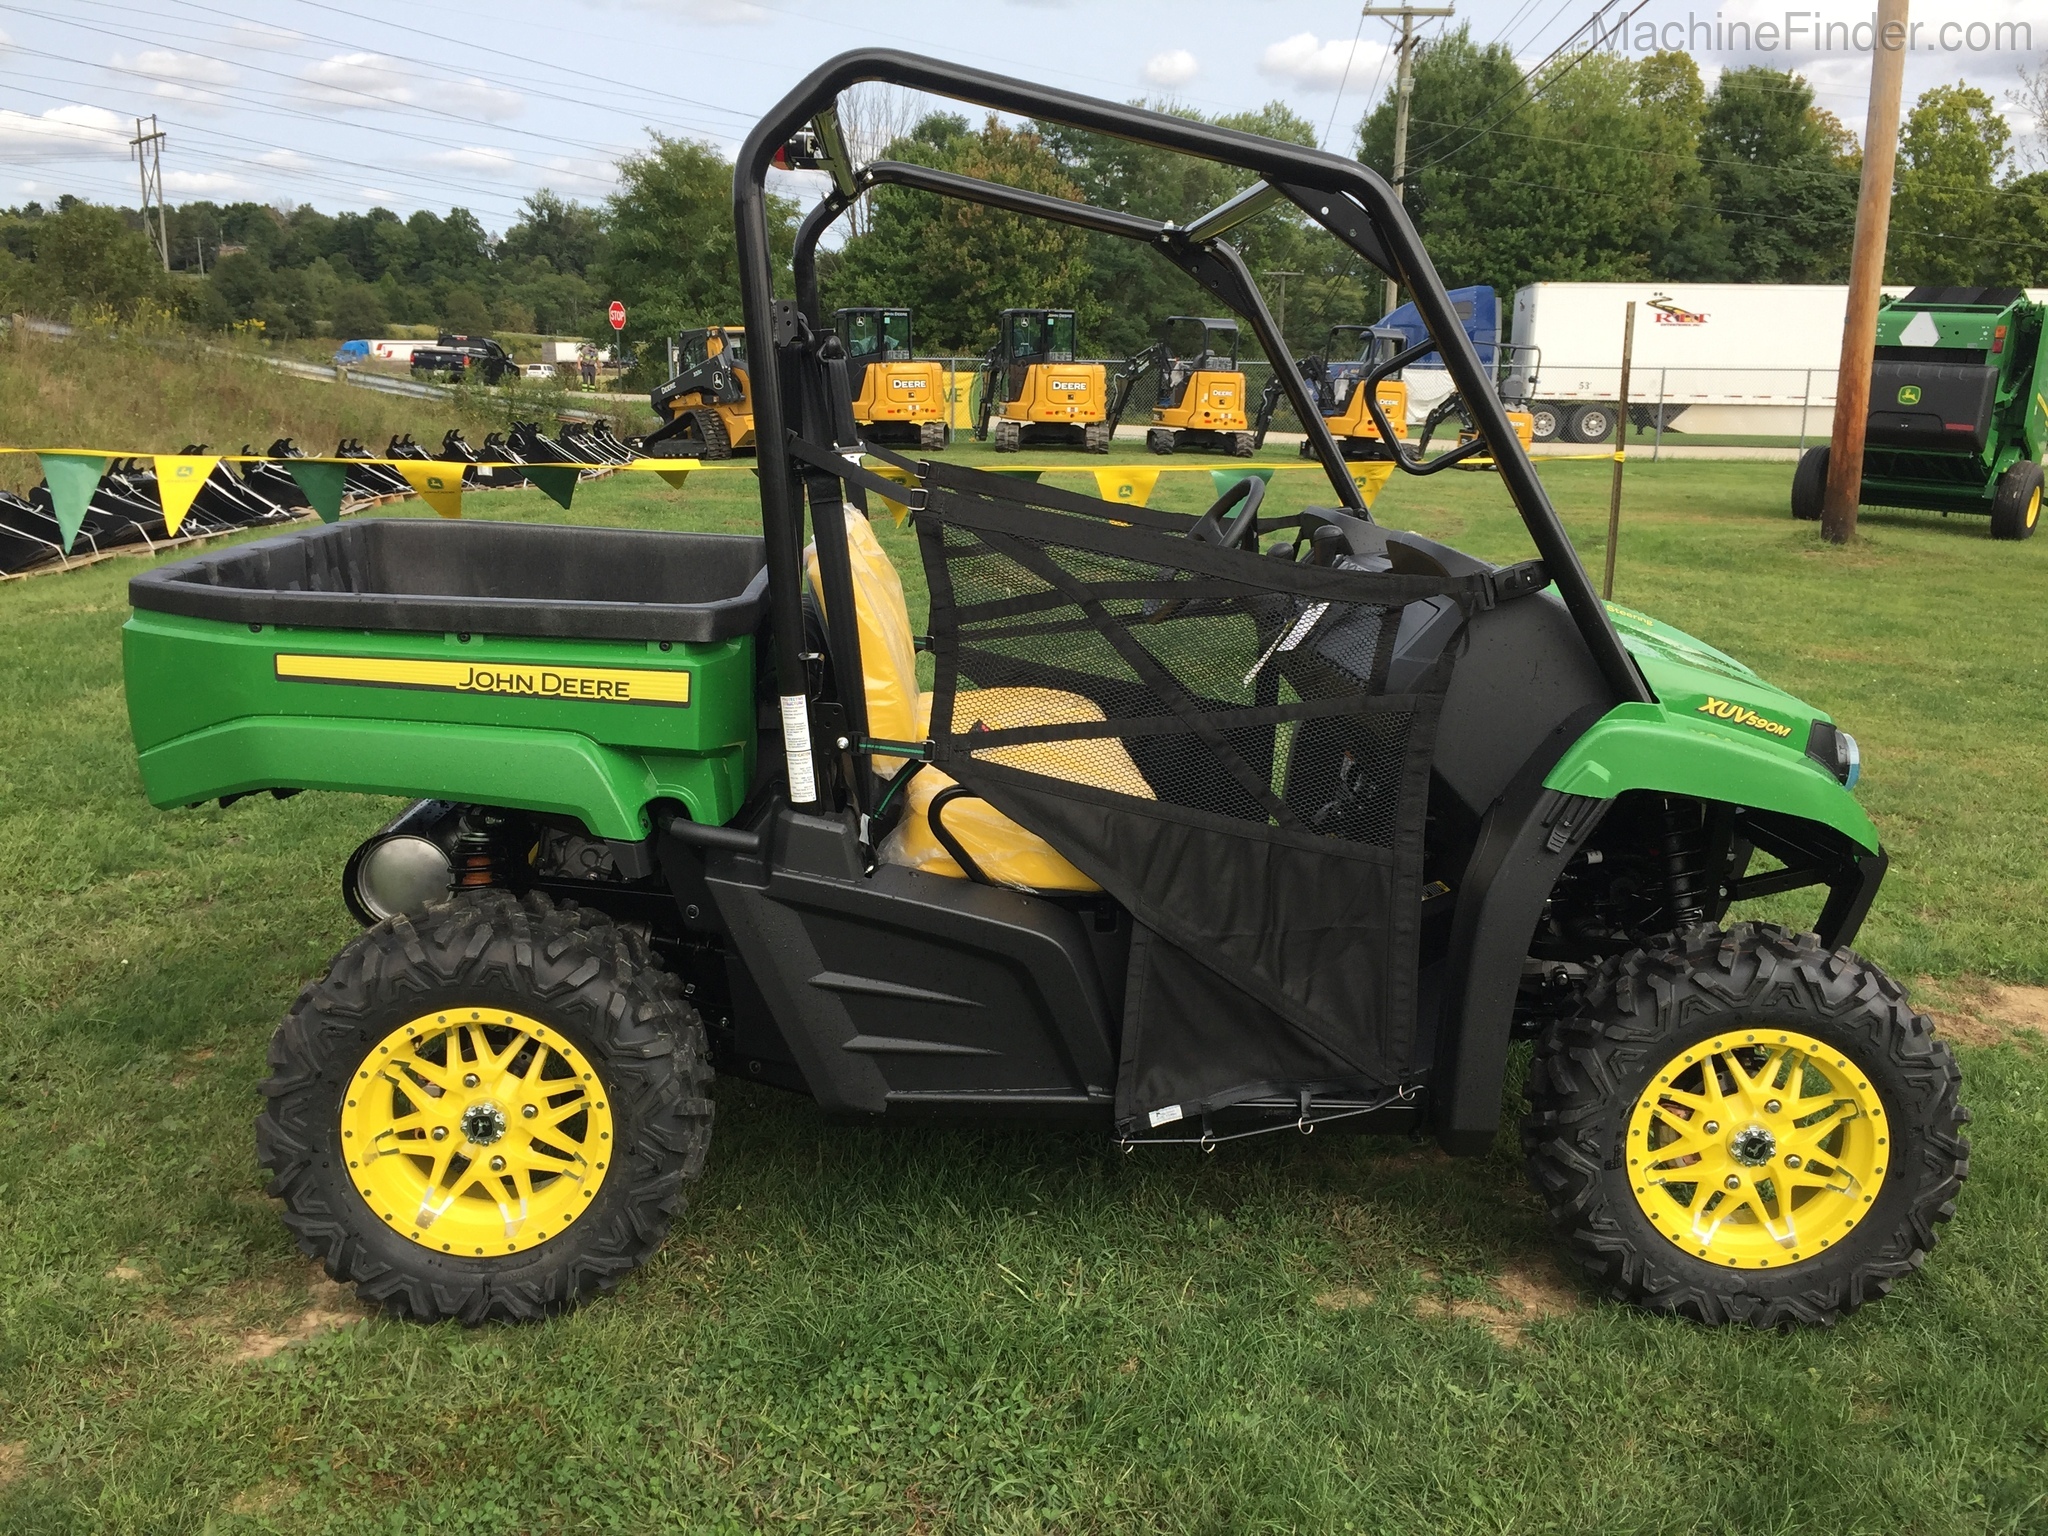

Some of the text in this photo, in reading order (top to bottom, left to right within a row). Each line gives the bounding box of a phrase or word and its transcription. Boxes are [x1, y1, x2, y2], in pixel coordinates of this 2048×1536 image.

[610, 310, 625, 321] STOP
[660, 381, 677, 395] DEERE
[893, 379, 927, 389] DEERE
[1052, 381, 1087, 390] DEERE
[1212, 389, 1233, 397] DEERE
[1606, 604, 1654, 627] Steering
[459, 667, 630, 698] JOHN DEERE
[1696, 695, 1793, 738] XUV590M
